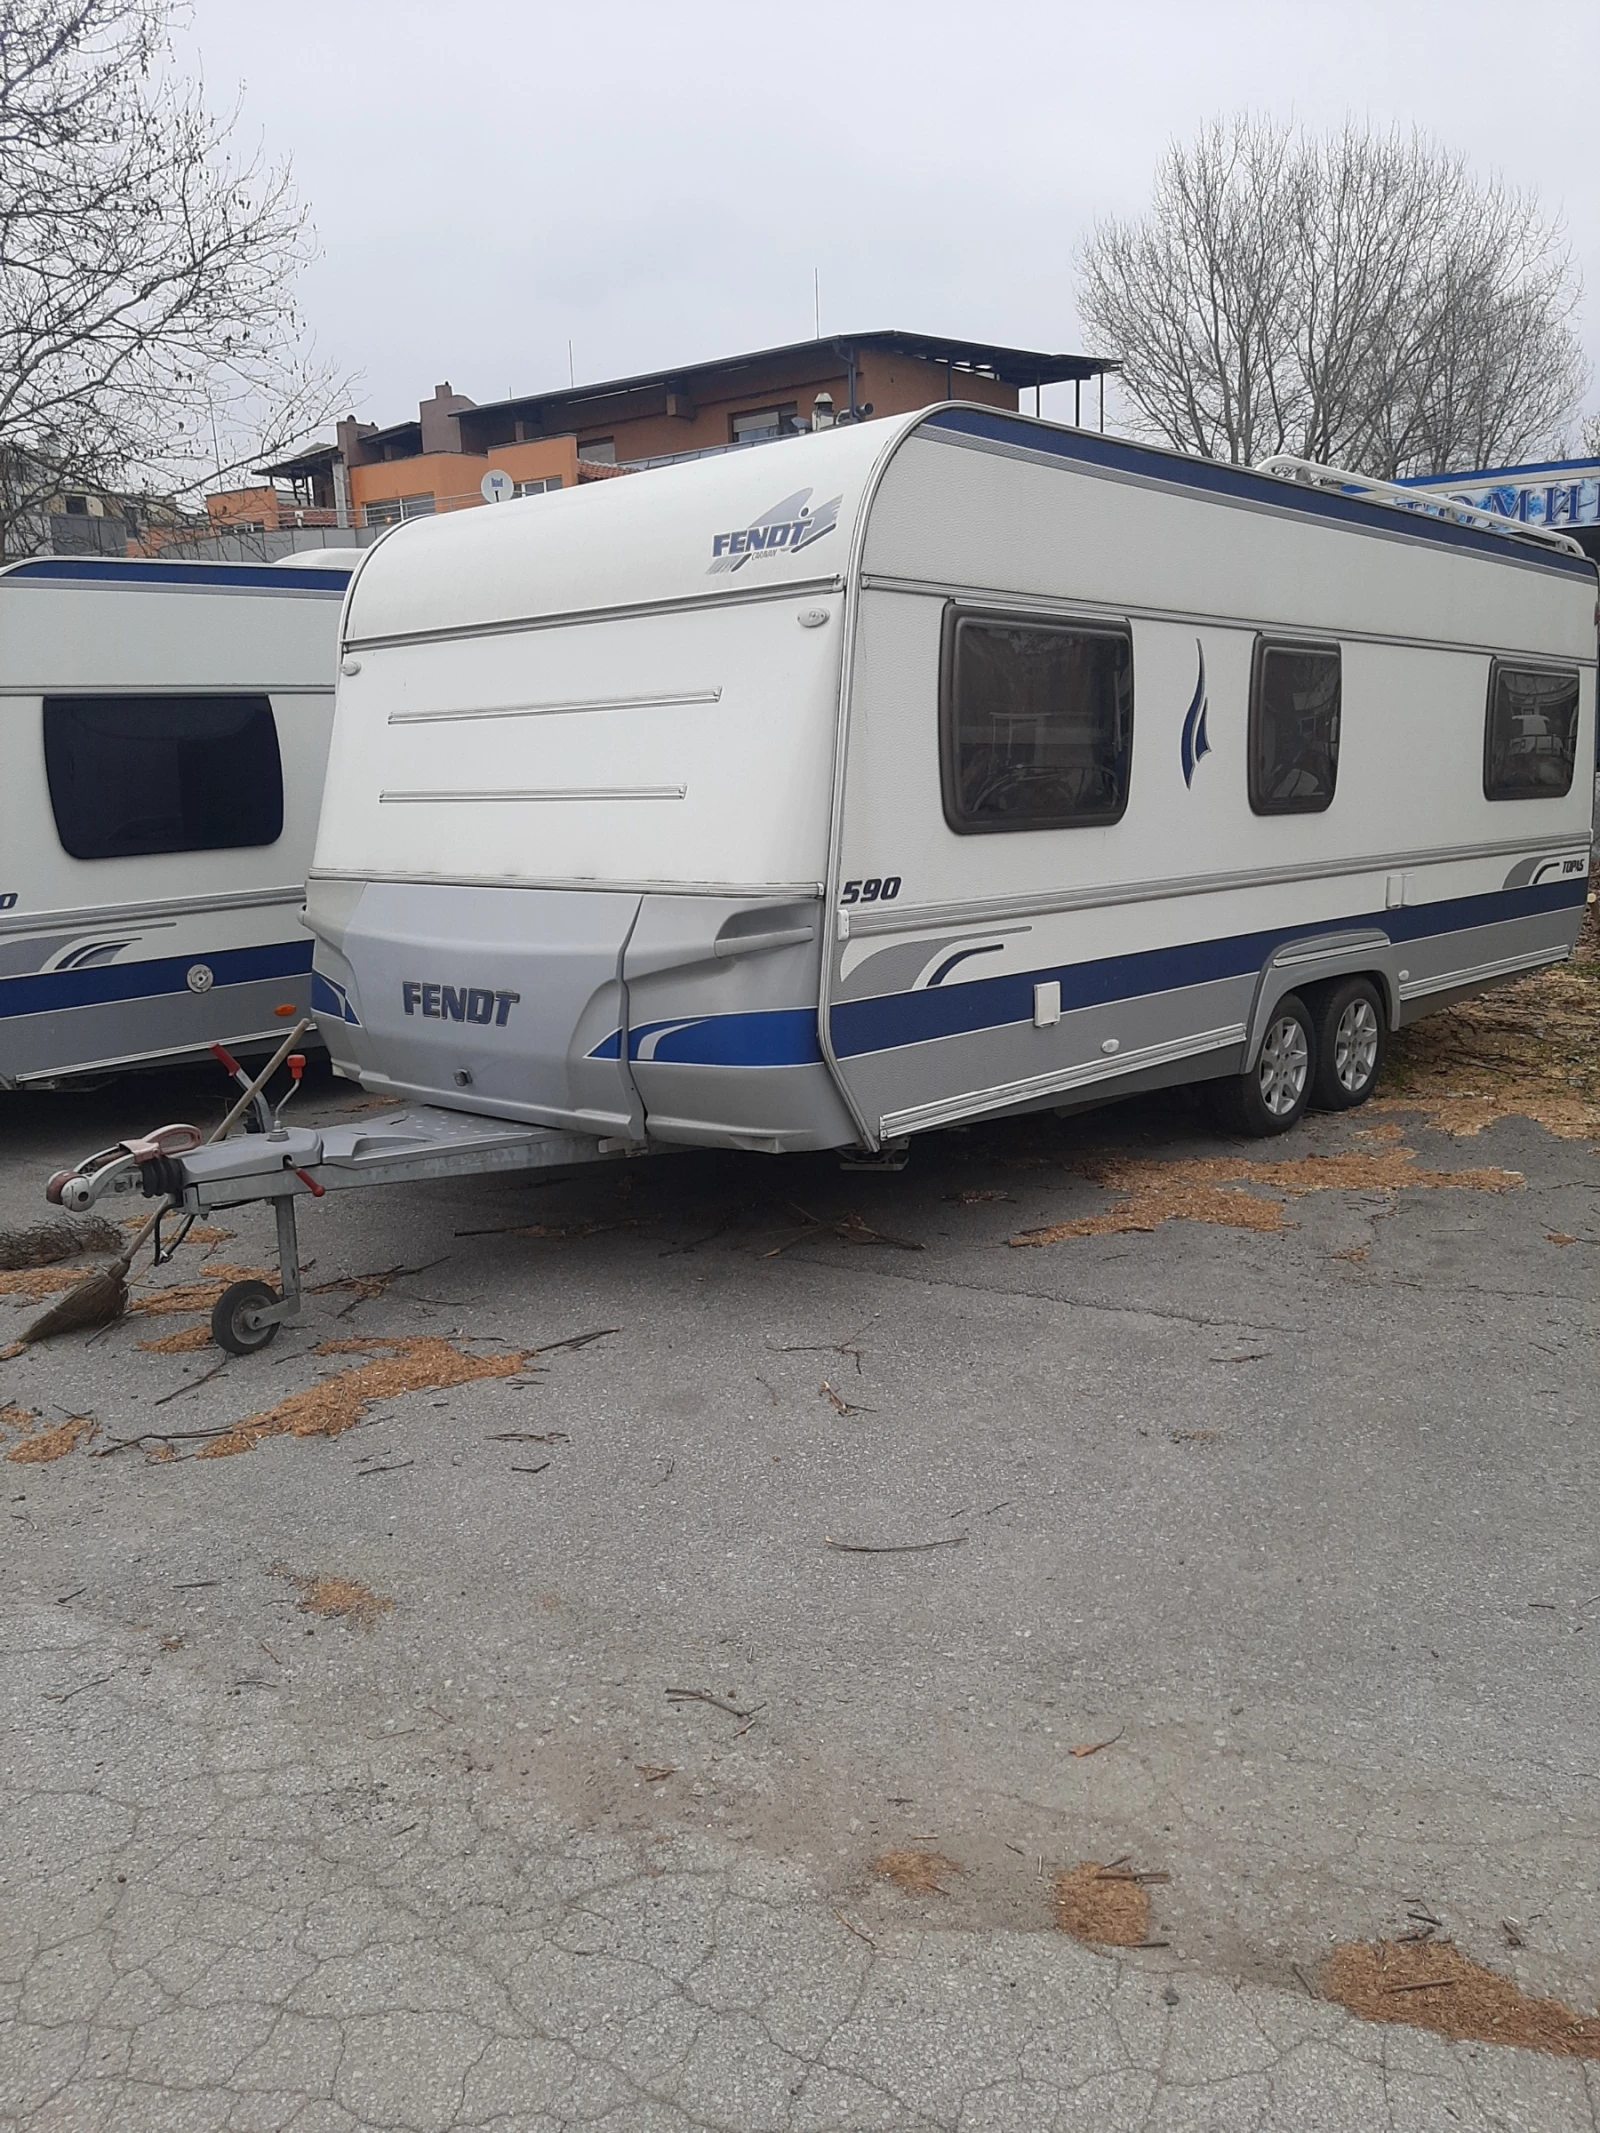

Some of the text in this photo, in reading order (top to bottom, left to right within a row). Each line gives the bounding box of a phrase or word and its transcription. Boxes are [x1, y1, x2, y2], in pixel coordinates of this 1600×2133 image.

[712, 518, 813, 558] FENDT
[840, 876, 902, 905] 590
[402, 981, 521, 1028] FENDT
